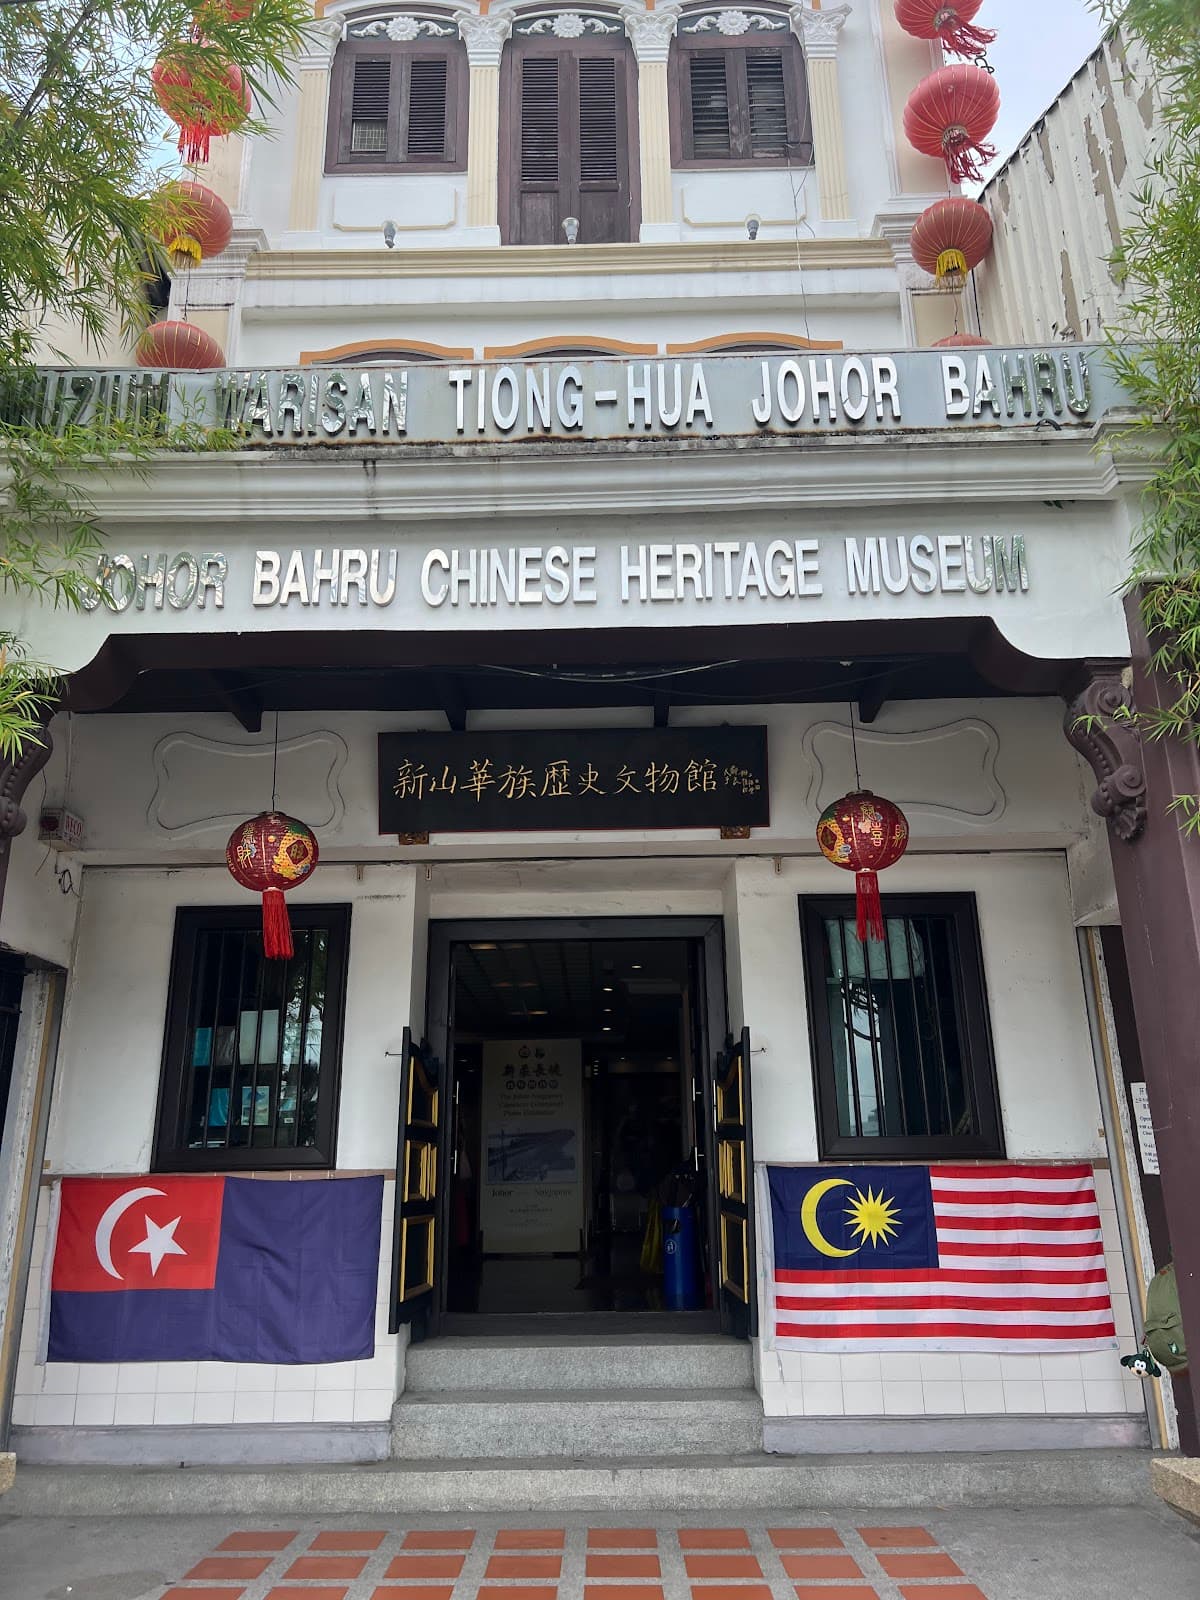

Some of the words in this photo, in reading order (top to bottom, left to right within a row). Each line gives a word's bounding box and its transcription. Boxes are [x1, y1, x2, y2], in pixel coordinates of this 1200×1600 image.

[215, 371, 408, 436] WARISAN
[448, 363, 714, 433] TIONG-HUA
[752, 356, 901, 425] JOHOR
[940, 351, 1091, 419] BAHRU
[80, 551, 229, 611] JOHOR
[252, 548, 399, 609] BAHRU
[420, 545, 598, 607] CHINESE
[620, 539, 823, 602] HERITAGE
[845, 533, 1030, 597] MUSEUM
